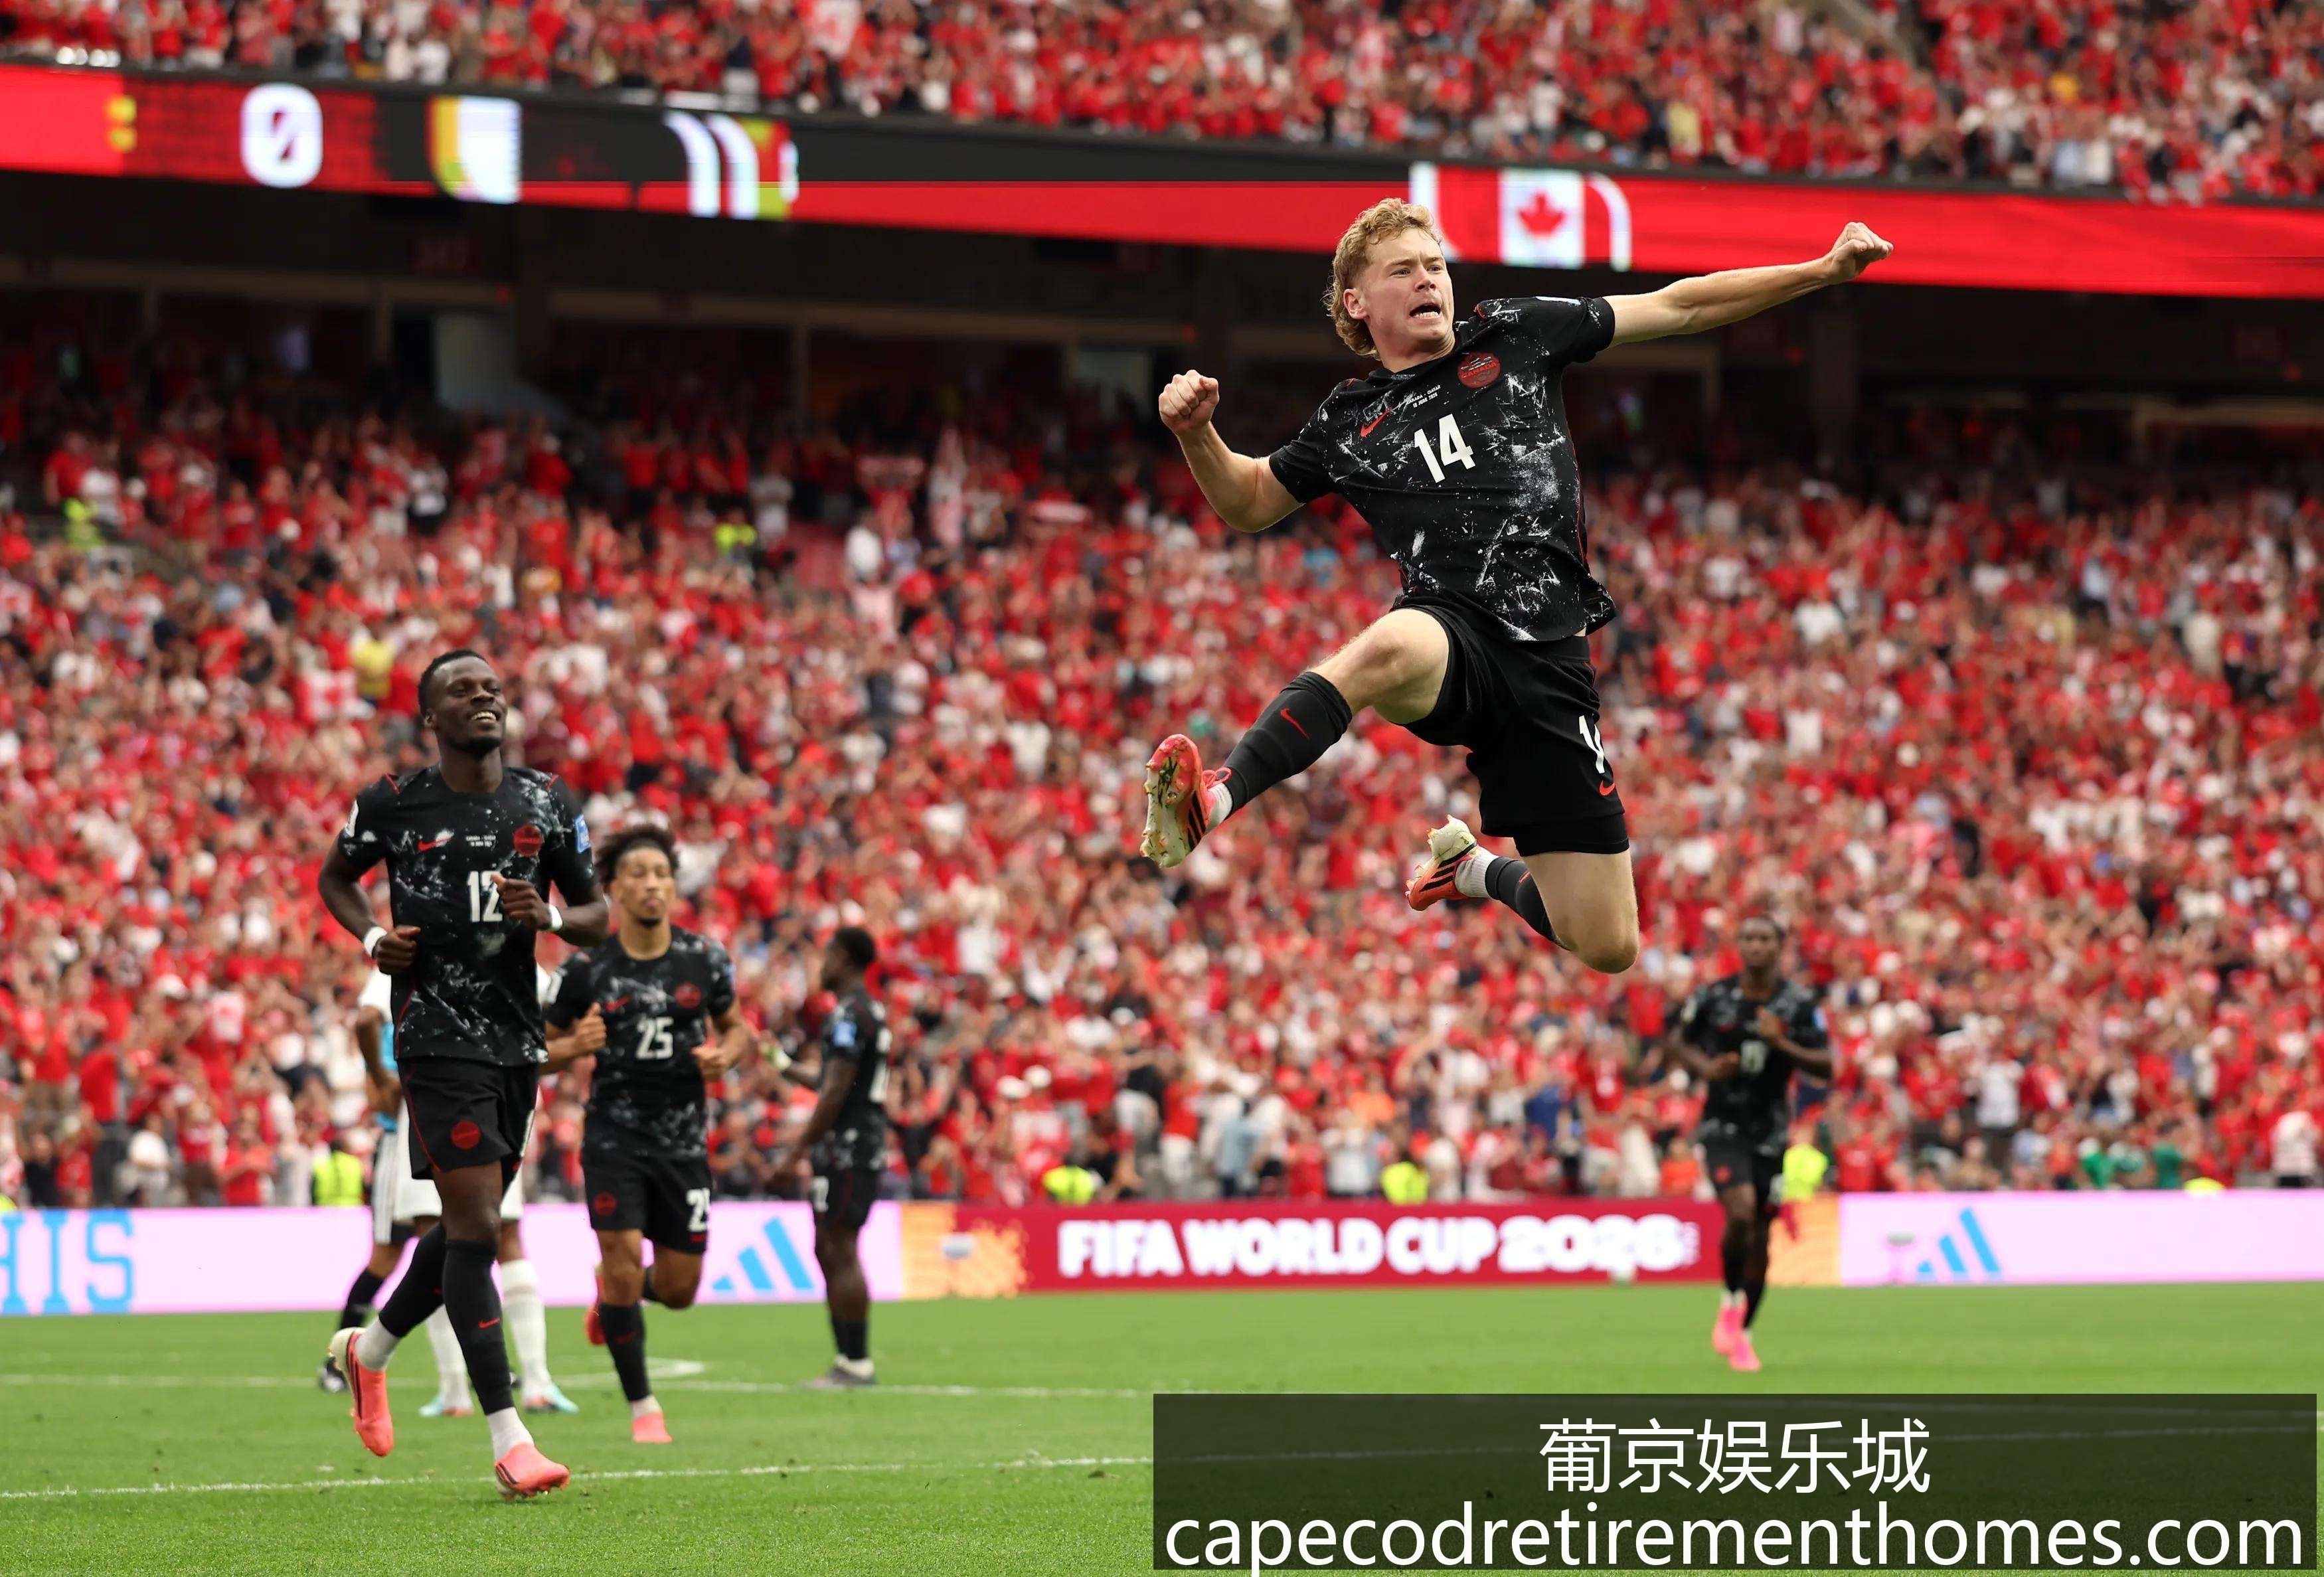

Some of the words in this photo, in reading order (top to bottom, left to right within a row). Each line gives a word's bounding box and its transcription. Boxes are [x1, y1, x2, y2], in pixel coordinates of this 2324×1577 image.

[1414, 414, 1475, 483] 14
[467, 871, 503, 922] 12
[635, 1016, 674, 1060] 25
[1058, 1219, 1185, 1278] FIFA
[1181, 1217, 1385, 1276] WORLD
[1386, 1216, 1497, 1275] CUP
[1497, 1214, 1685, 1274] 2026
